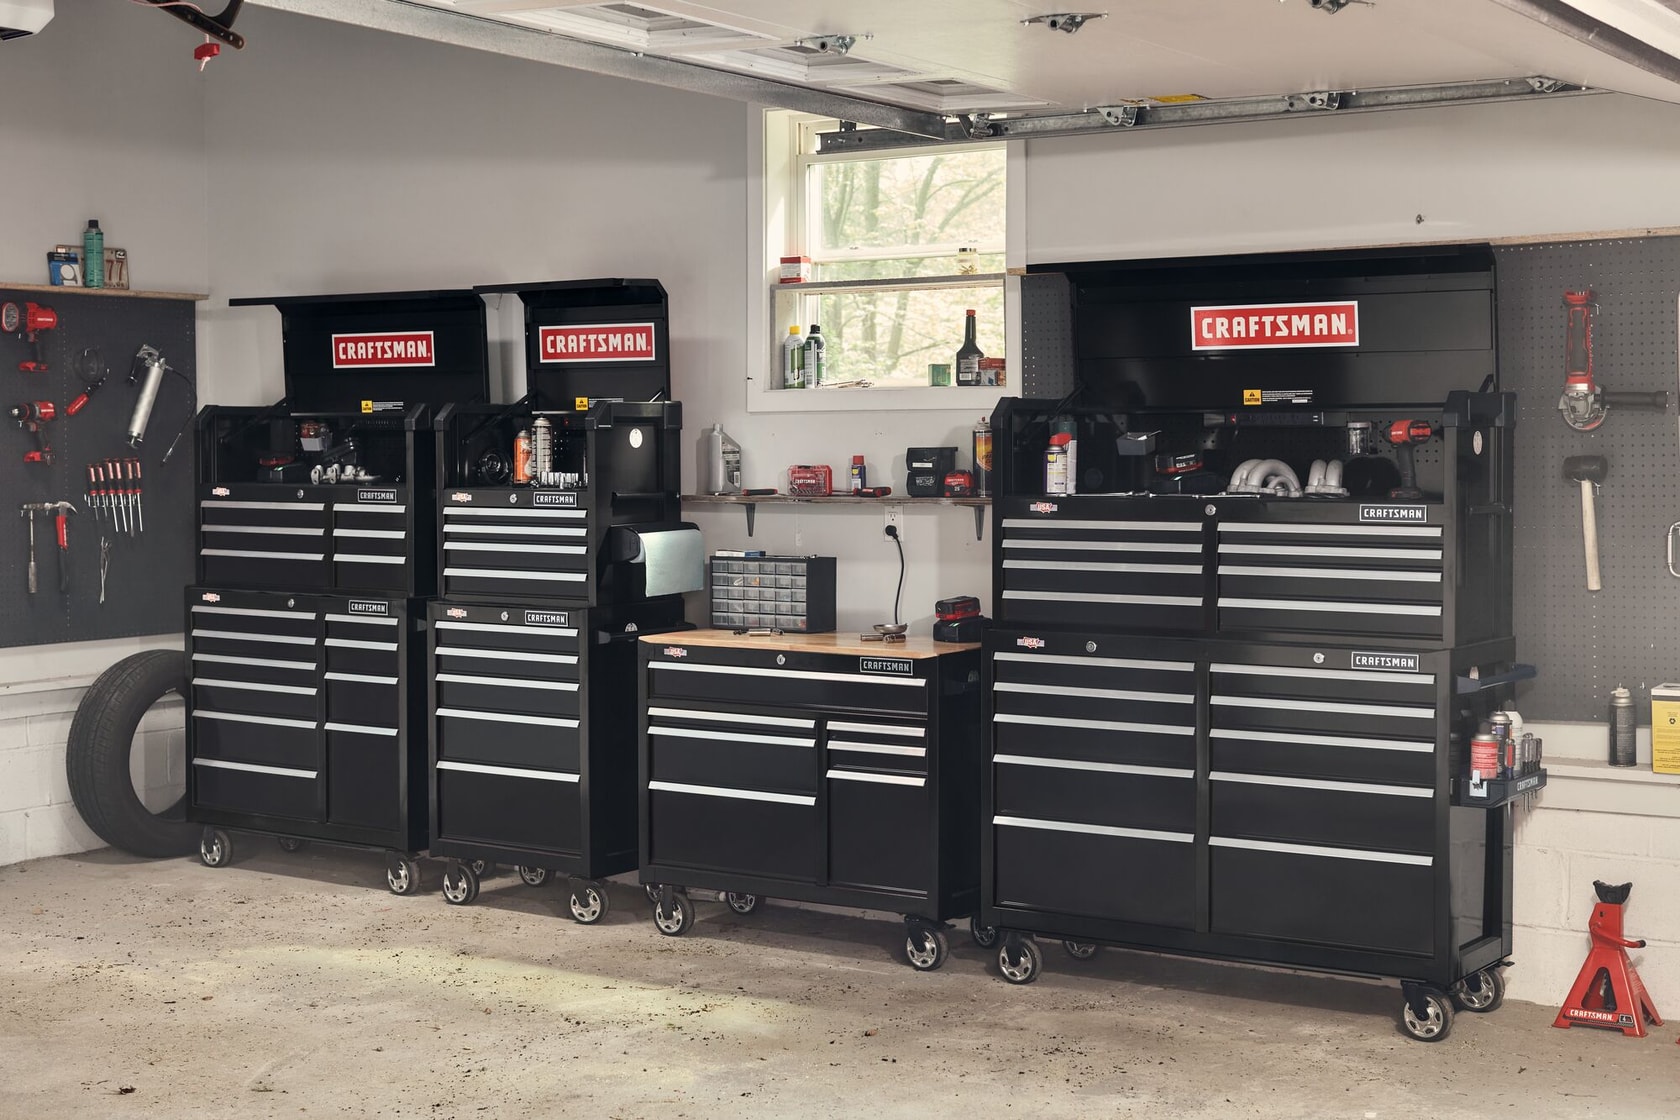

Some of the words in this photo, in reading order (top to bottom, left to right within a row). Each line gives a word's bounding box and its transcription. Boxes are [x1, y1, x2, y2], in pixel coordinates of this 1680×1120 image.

[1201, 313, 1346, 339] CRAFTSMAN
[546, 332, 647, 353] CRAFTSMAN
[338, 340, 427, 360] CRAFTSMAN
[360, 492, 394, 500] CRAFTSMAN
[536, 495, 574, 504] CRAFTSMAN
[1363, 509, 1422, 518] CRAFTSMAN
[352, 603, 386, 612] CRAFTSMAN
[527, 614, 565, 623] CRAFTSMAN
[863, 661, 909, 672] CRAFTSMAN
[1355, 656, 1415, 668] CRAFTSMAN
[1570, 1009, 1613, 1021] CRAFTSMAN
